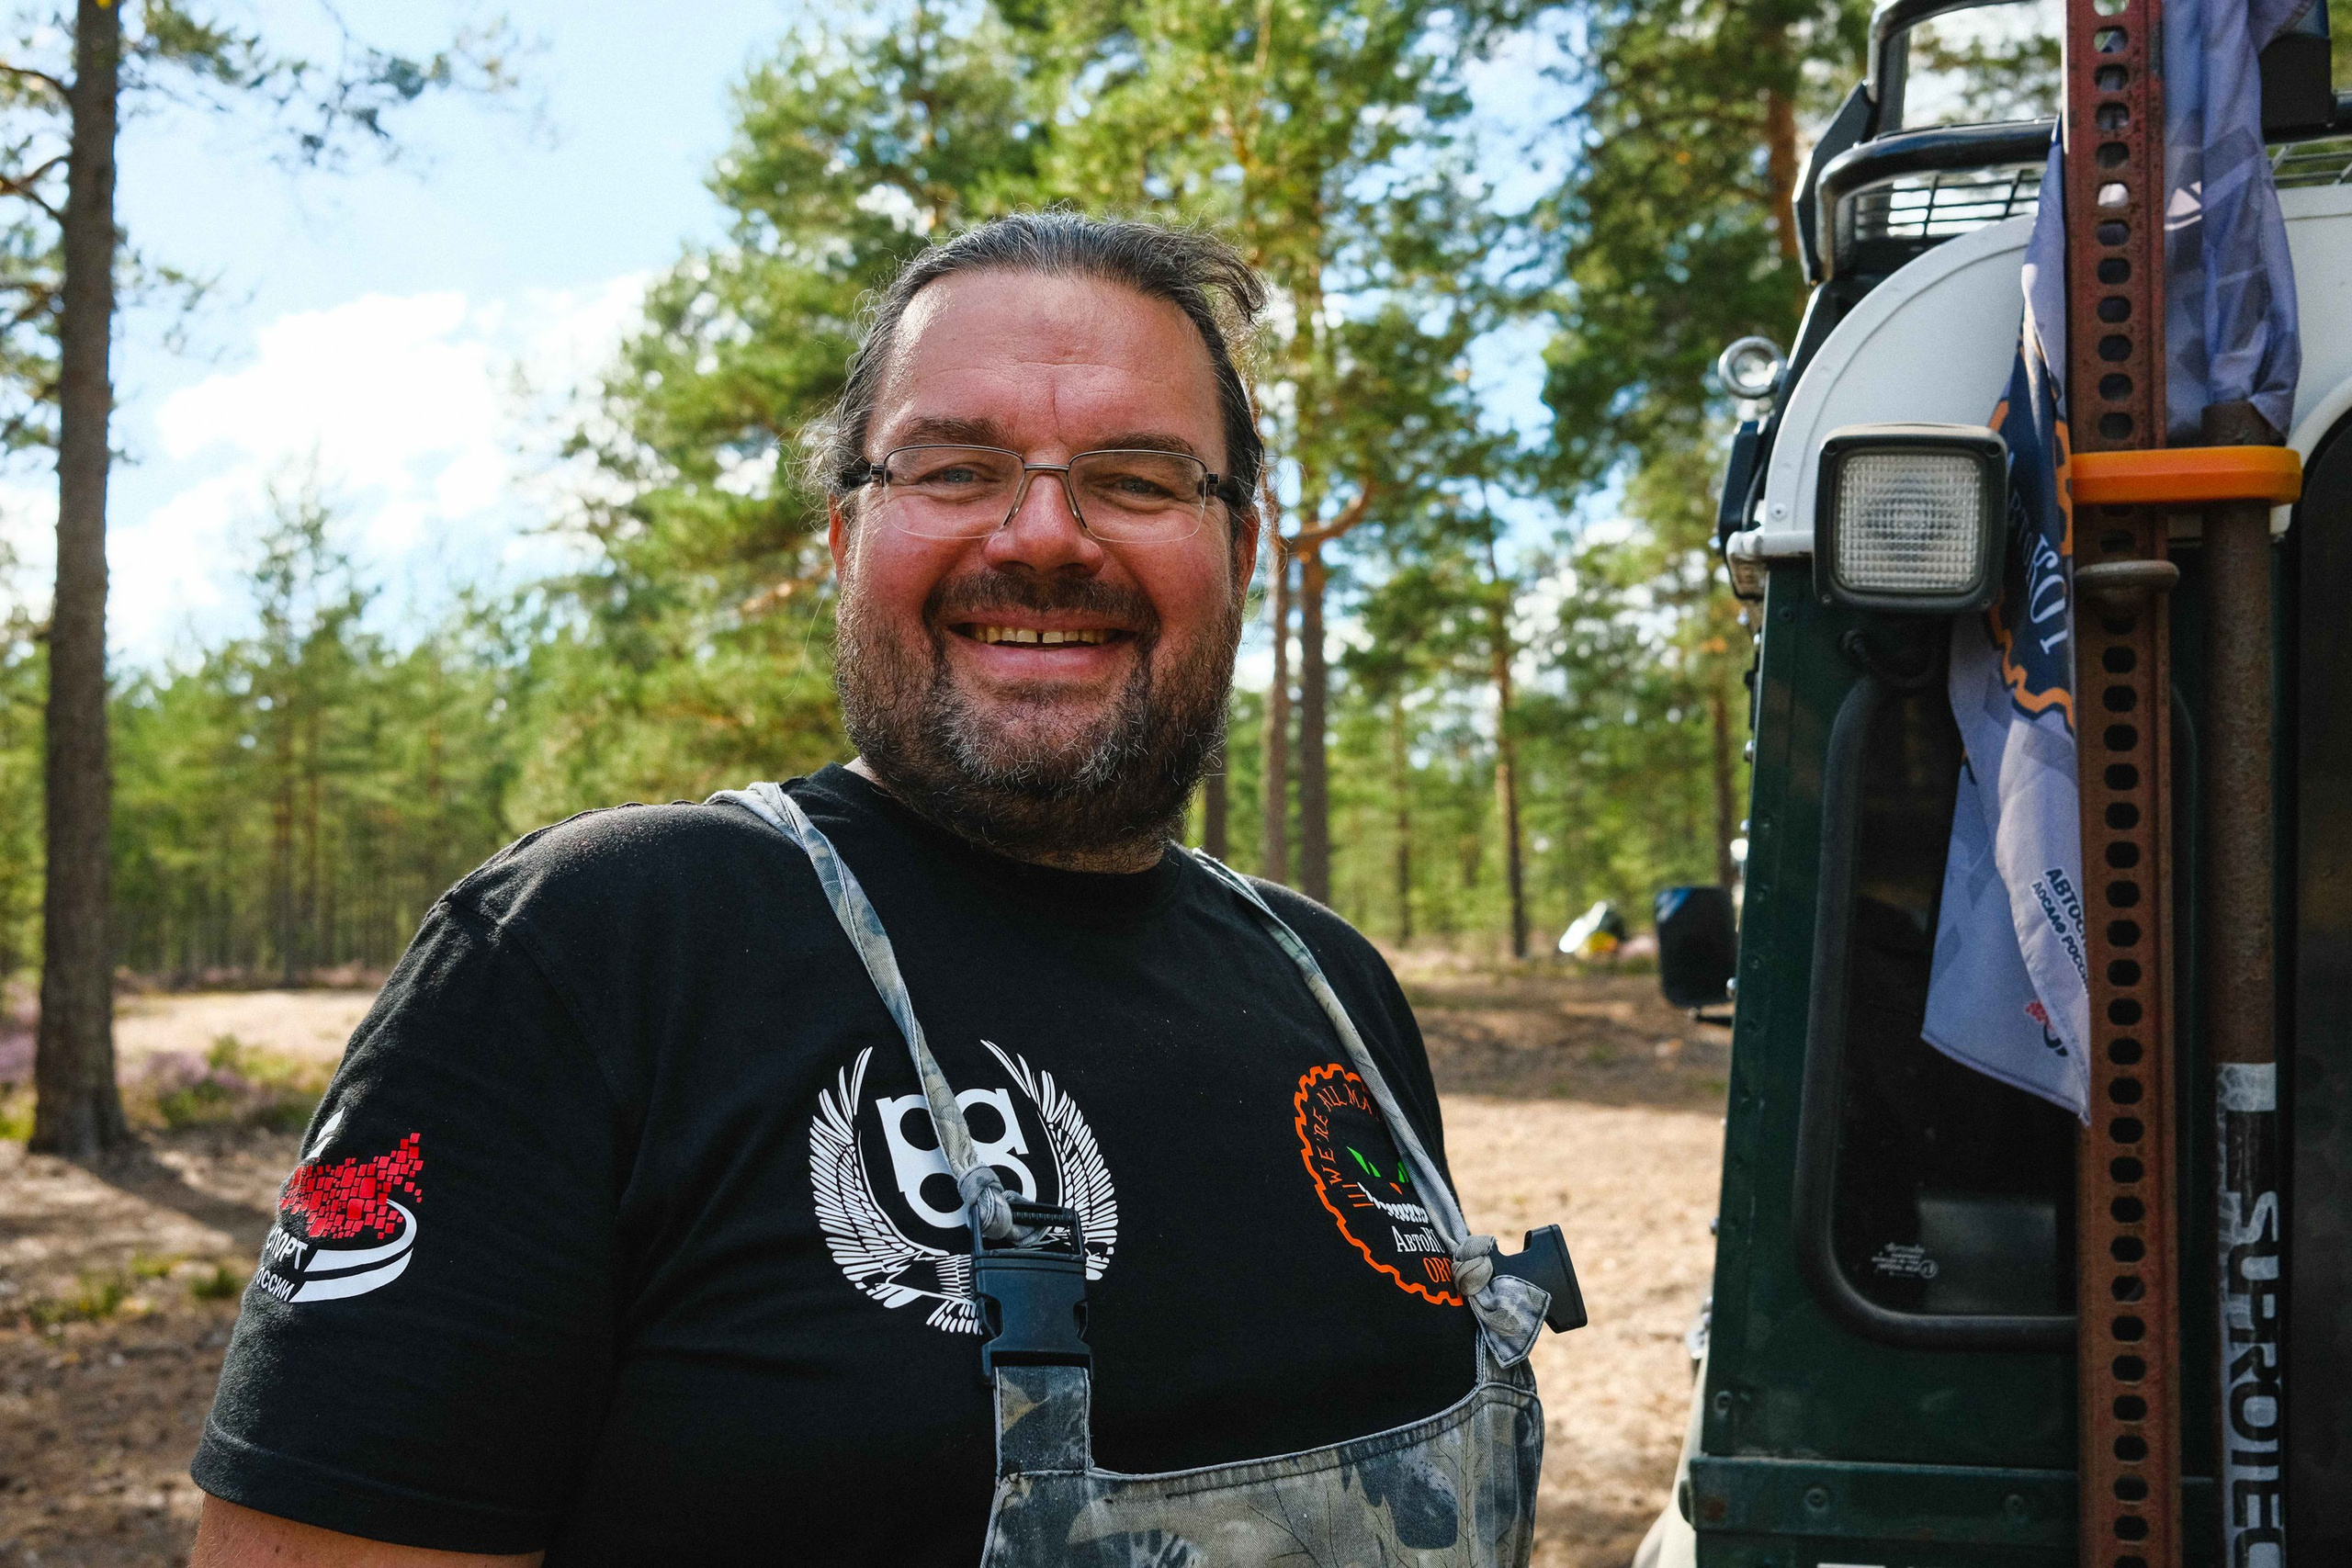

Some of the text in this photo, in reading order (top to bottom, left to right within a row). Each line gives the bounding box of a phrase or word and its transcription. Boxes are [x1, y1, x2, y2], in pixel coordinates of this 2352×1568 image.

[2045, 868, 2085, 943] АВТОС
[1342, 1083, 1377, 1120] MA
[255, 1266, 296, 1303] ОССИИ
